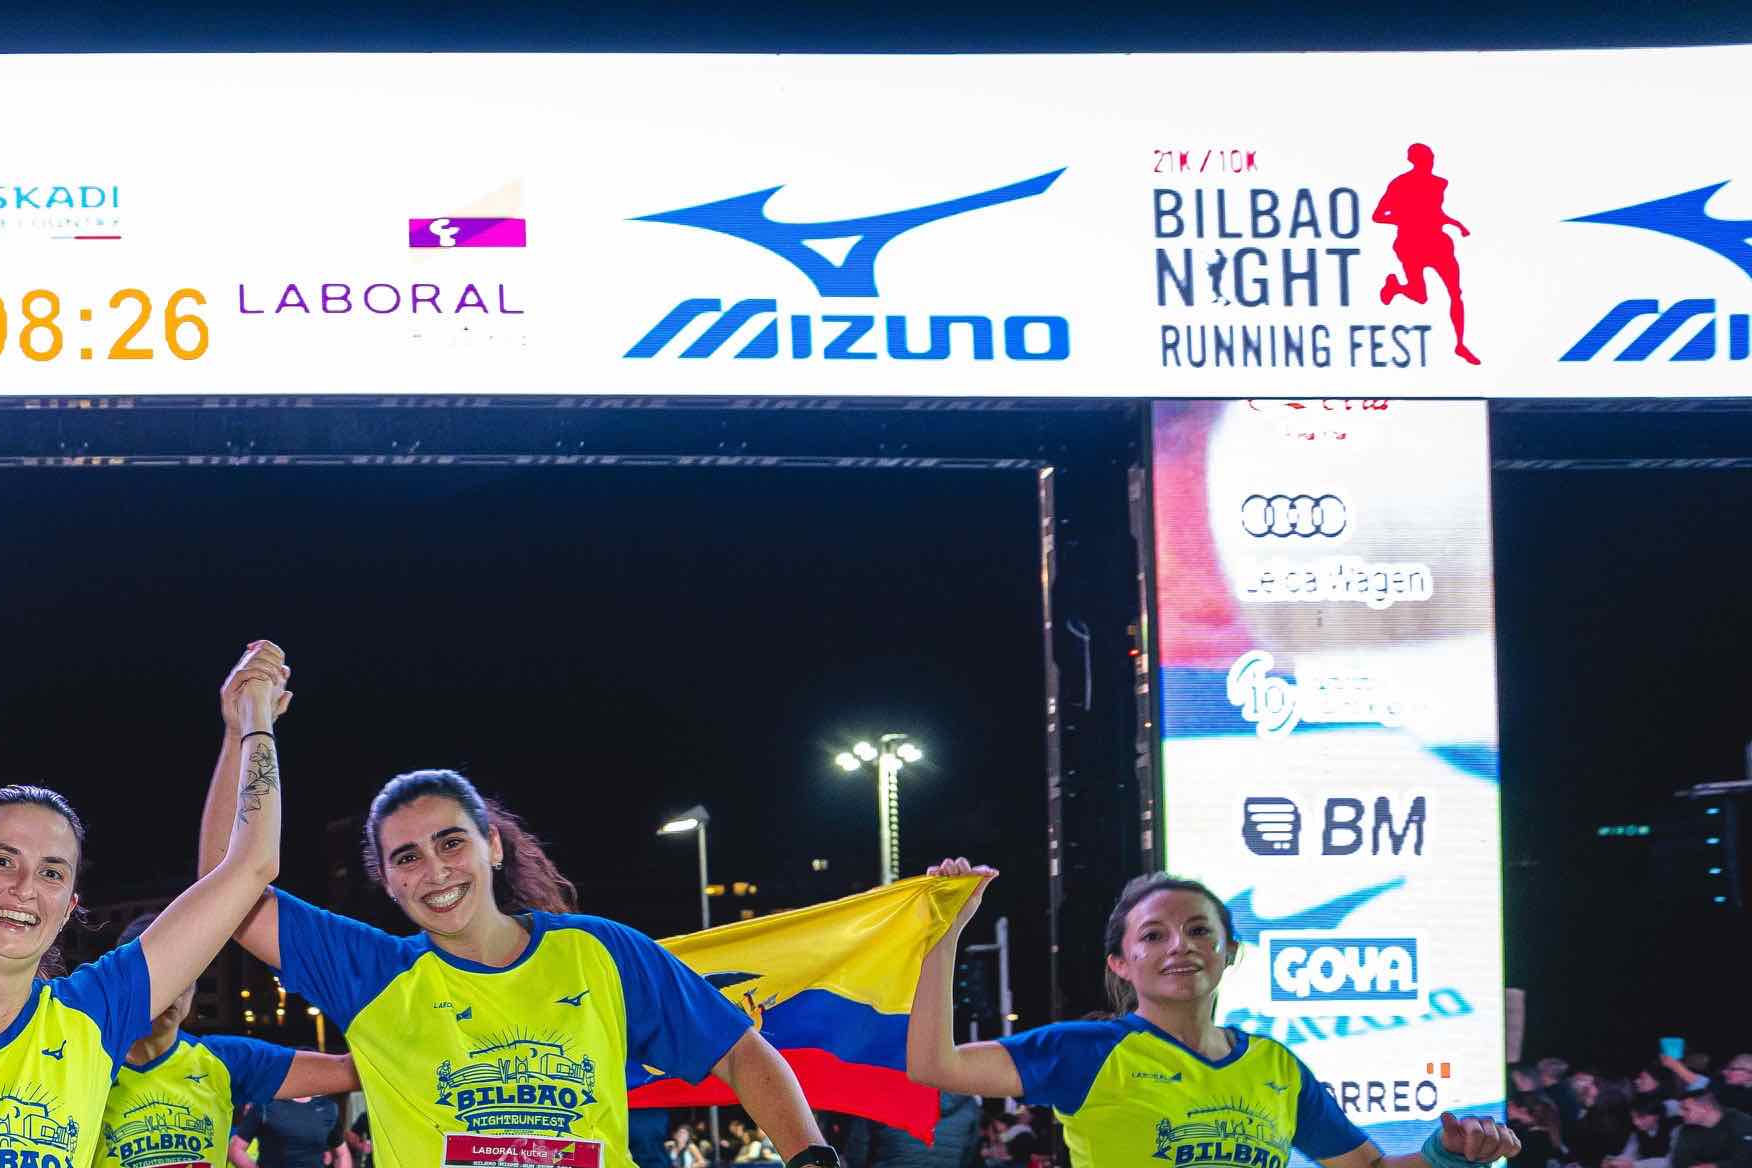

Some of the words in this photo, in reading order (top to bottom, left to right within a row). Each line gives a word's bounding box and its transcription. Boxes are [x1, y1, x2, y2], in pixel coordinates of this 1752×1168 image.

[1153, 187, 1360, 240] BILBAO
[1155, 247, 1361, 307] NIGHT
[238, 282, 525, 315] LABORAL
[1160, 324, 1331, 368] RUNNING
[1349, 324, 1432, 368] FEST
[1320, 795, 1426, 856] BM
[1272, 945, 1418, 998] GOYA
[457, 1084, 578, 1111] BILBAO
[1321, 1080, 1438, 1113] RREO
[472, 1114, 566, 1128] NIGHTRUNFEST
[120, 1133, 202, 1160] BILBAO
[472, 1145, 519, 1156] LABORAL
